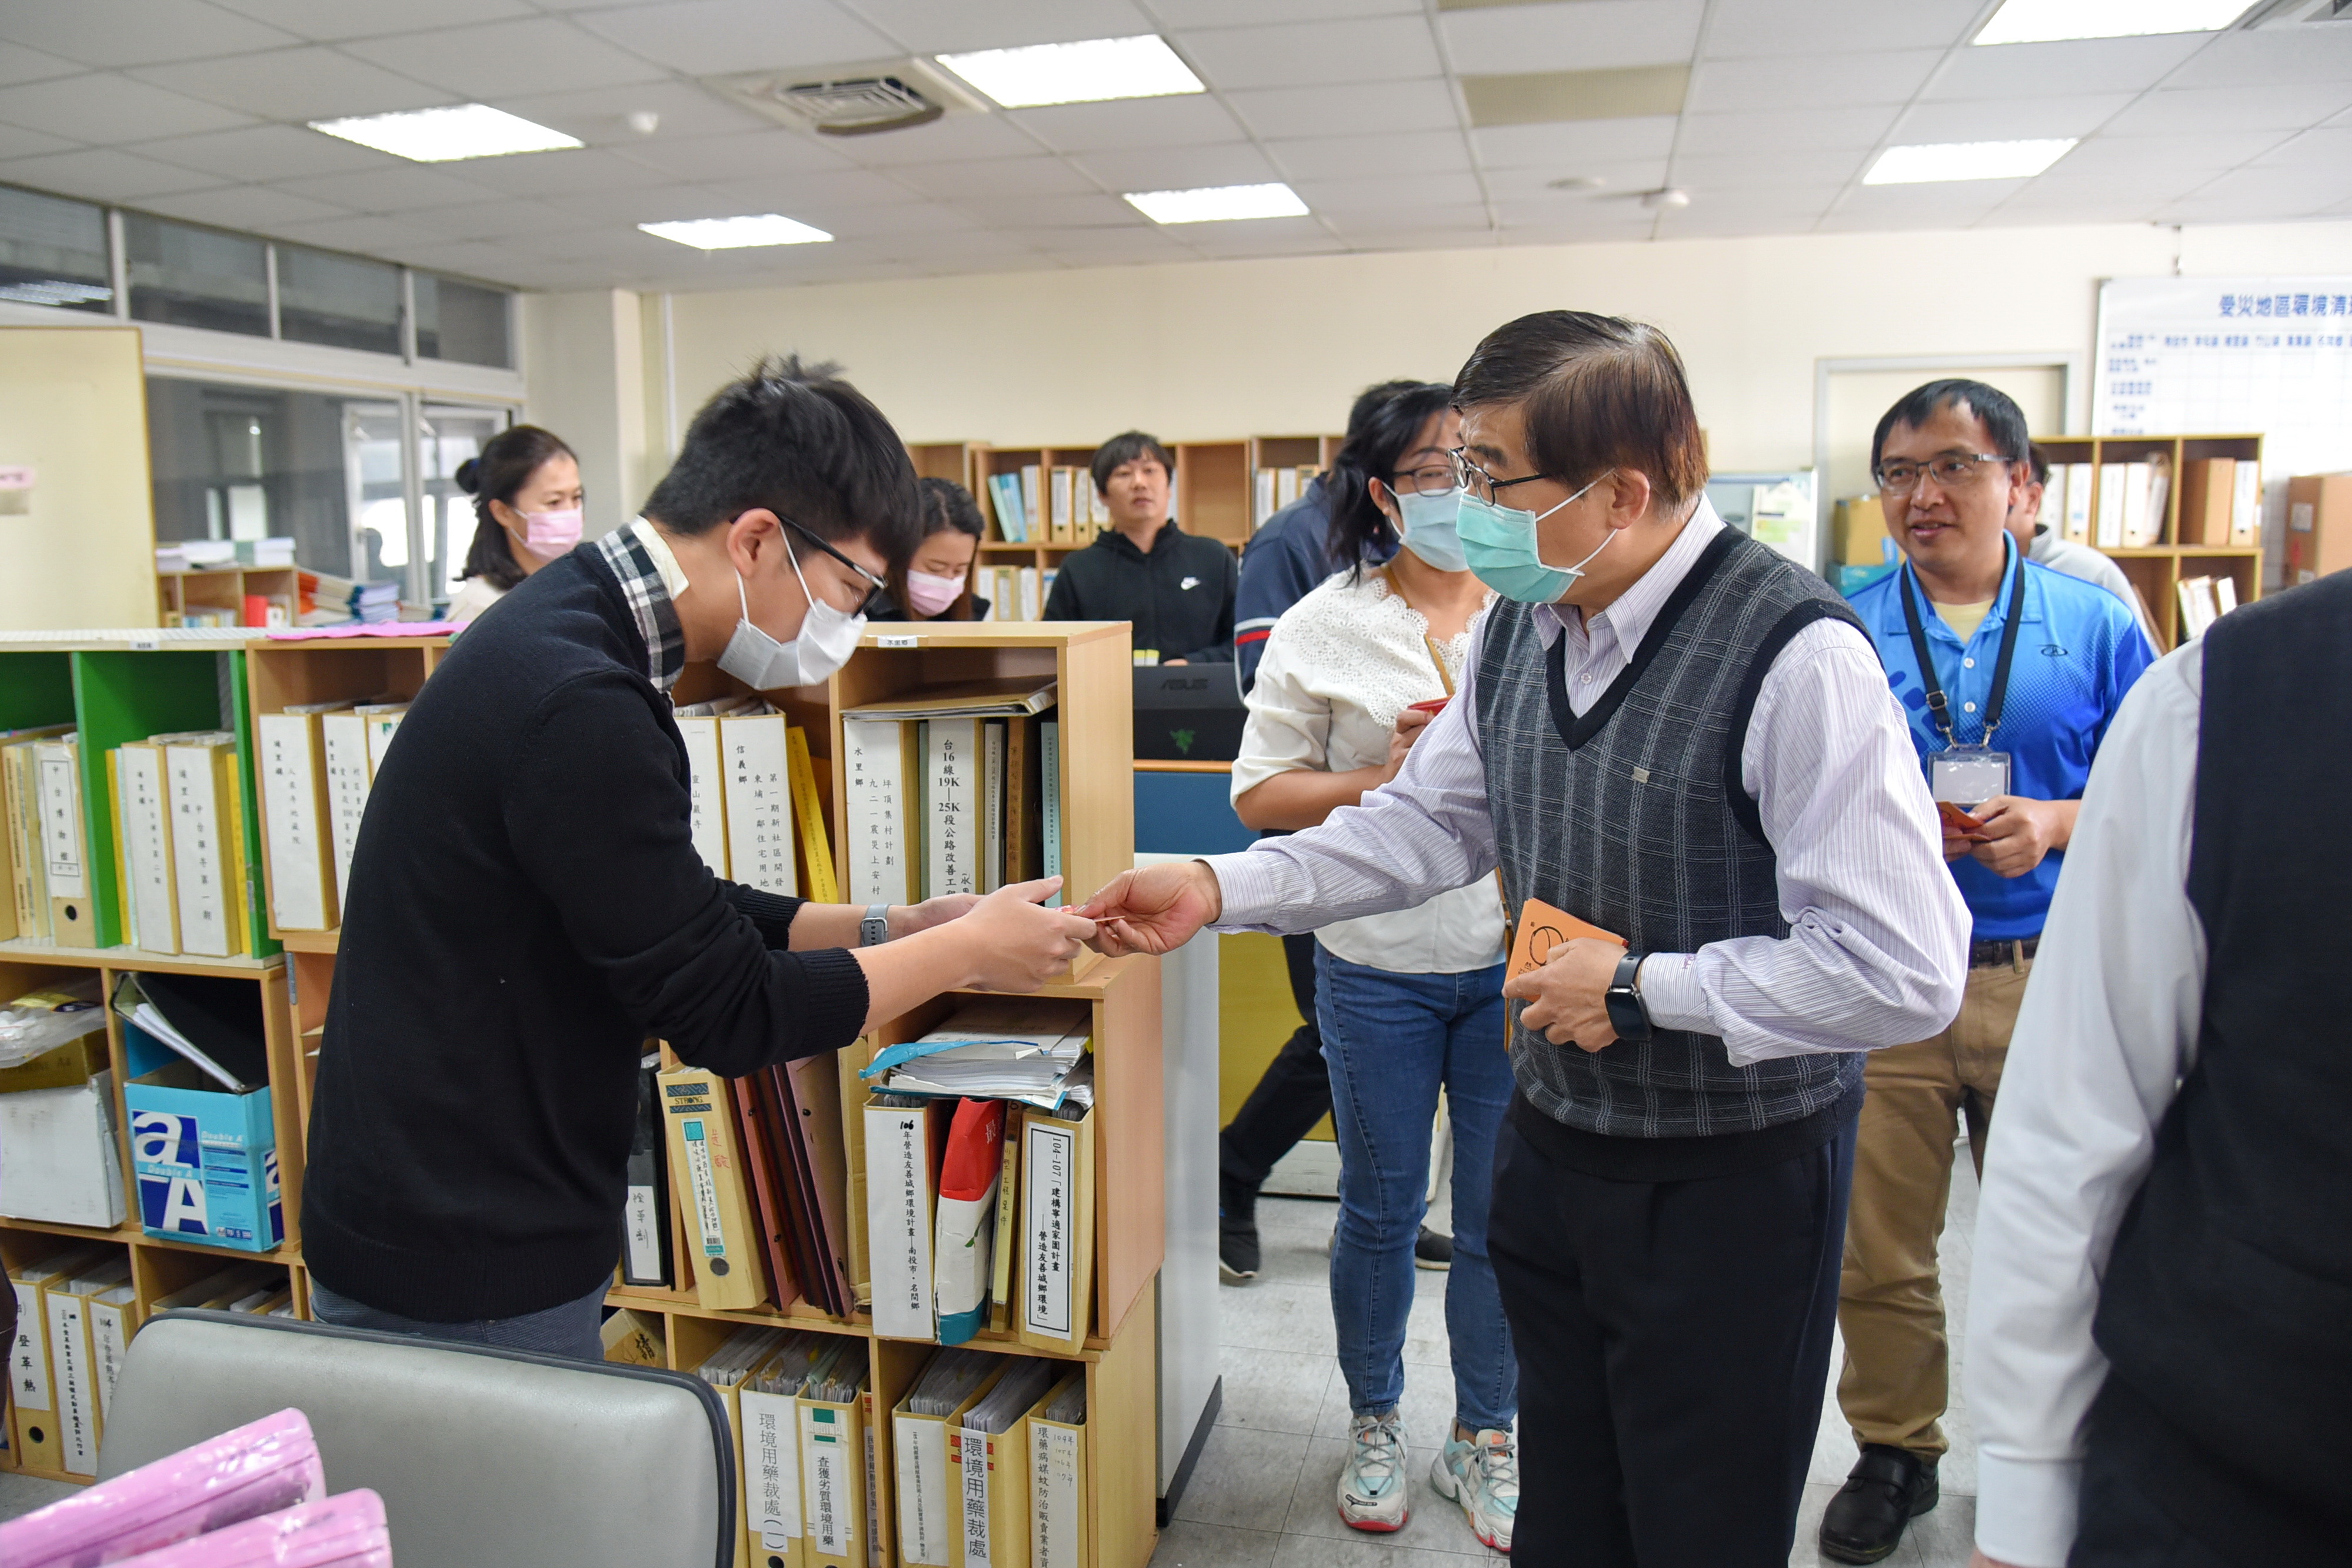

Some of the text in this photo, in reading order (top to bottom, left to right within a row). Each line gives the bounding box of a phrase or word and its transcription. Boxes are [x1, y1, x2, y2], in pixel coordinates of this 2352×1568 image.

[2220, 293, 2352, 318] 受災地區環境清
[1161, 678, 1208, 690] ASUS
[736, 745, 747, 784] 信義鄉
[854, 746, 864, 786] 水里鄉
[769, 773, 784, 887] 第一期新社區開發
[869, 778, 880, 895] 九二一震災上安村
[882, 779, 894, 866] 坪頂集村計劃
[674, 1096, 704, 1105] STRONG
[18, 1334, 36, 1393] 登革熱
[817, 1455, 835, 1547] 查獲劣質環境用藥
[963, 1436, 987, 1559] 環境用藥裁處
